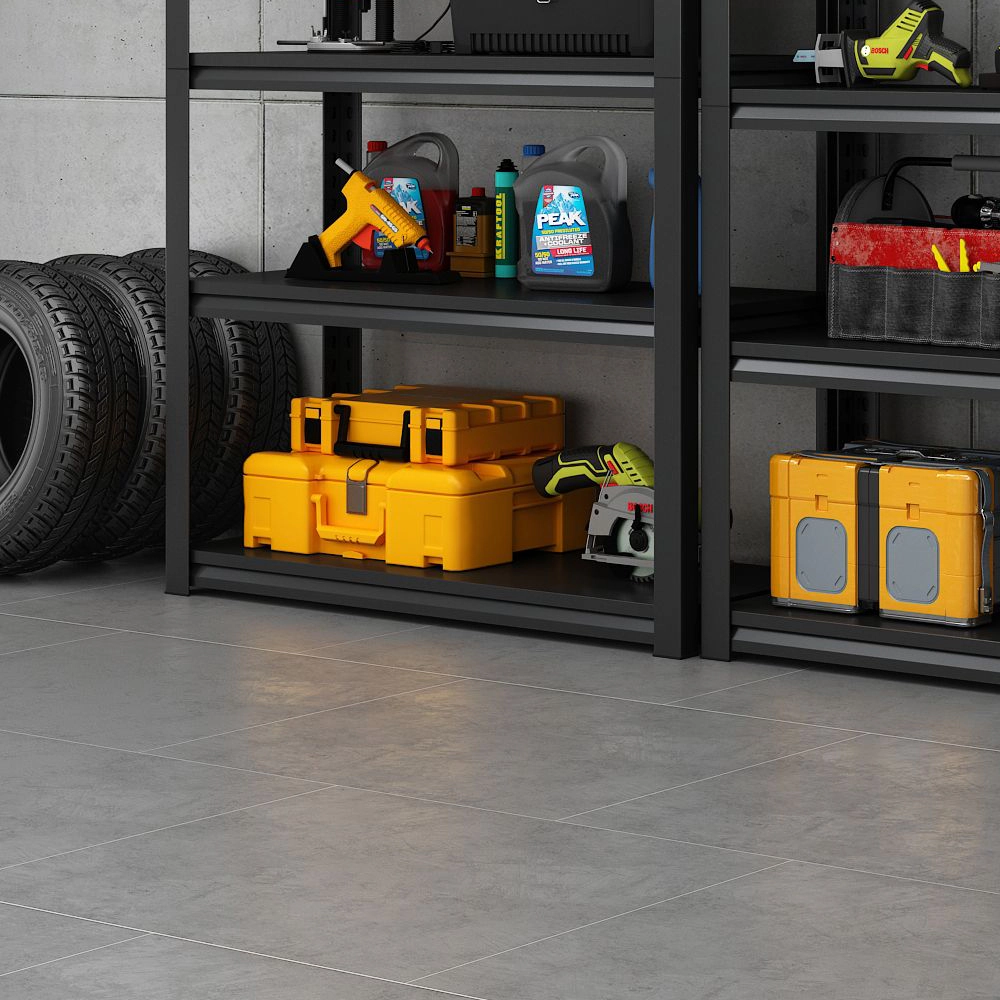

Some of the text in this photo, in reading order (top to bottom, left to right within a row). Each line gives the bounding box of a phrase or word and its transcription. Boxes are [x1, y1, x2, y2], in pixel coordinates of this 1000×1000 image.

[495, 192, 503, 259] KRAFTOOL
[536, 209, 586, 229] PEAK
[539, 233, 588, 242] ANTIFREEZE
[627, 502, 653, 513] BCH
